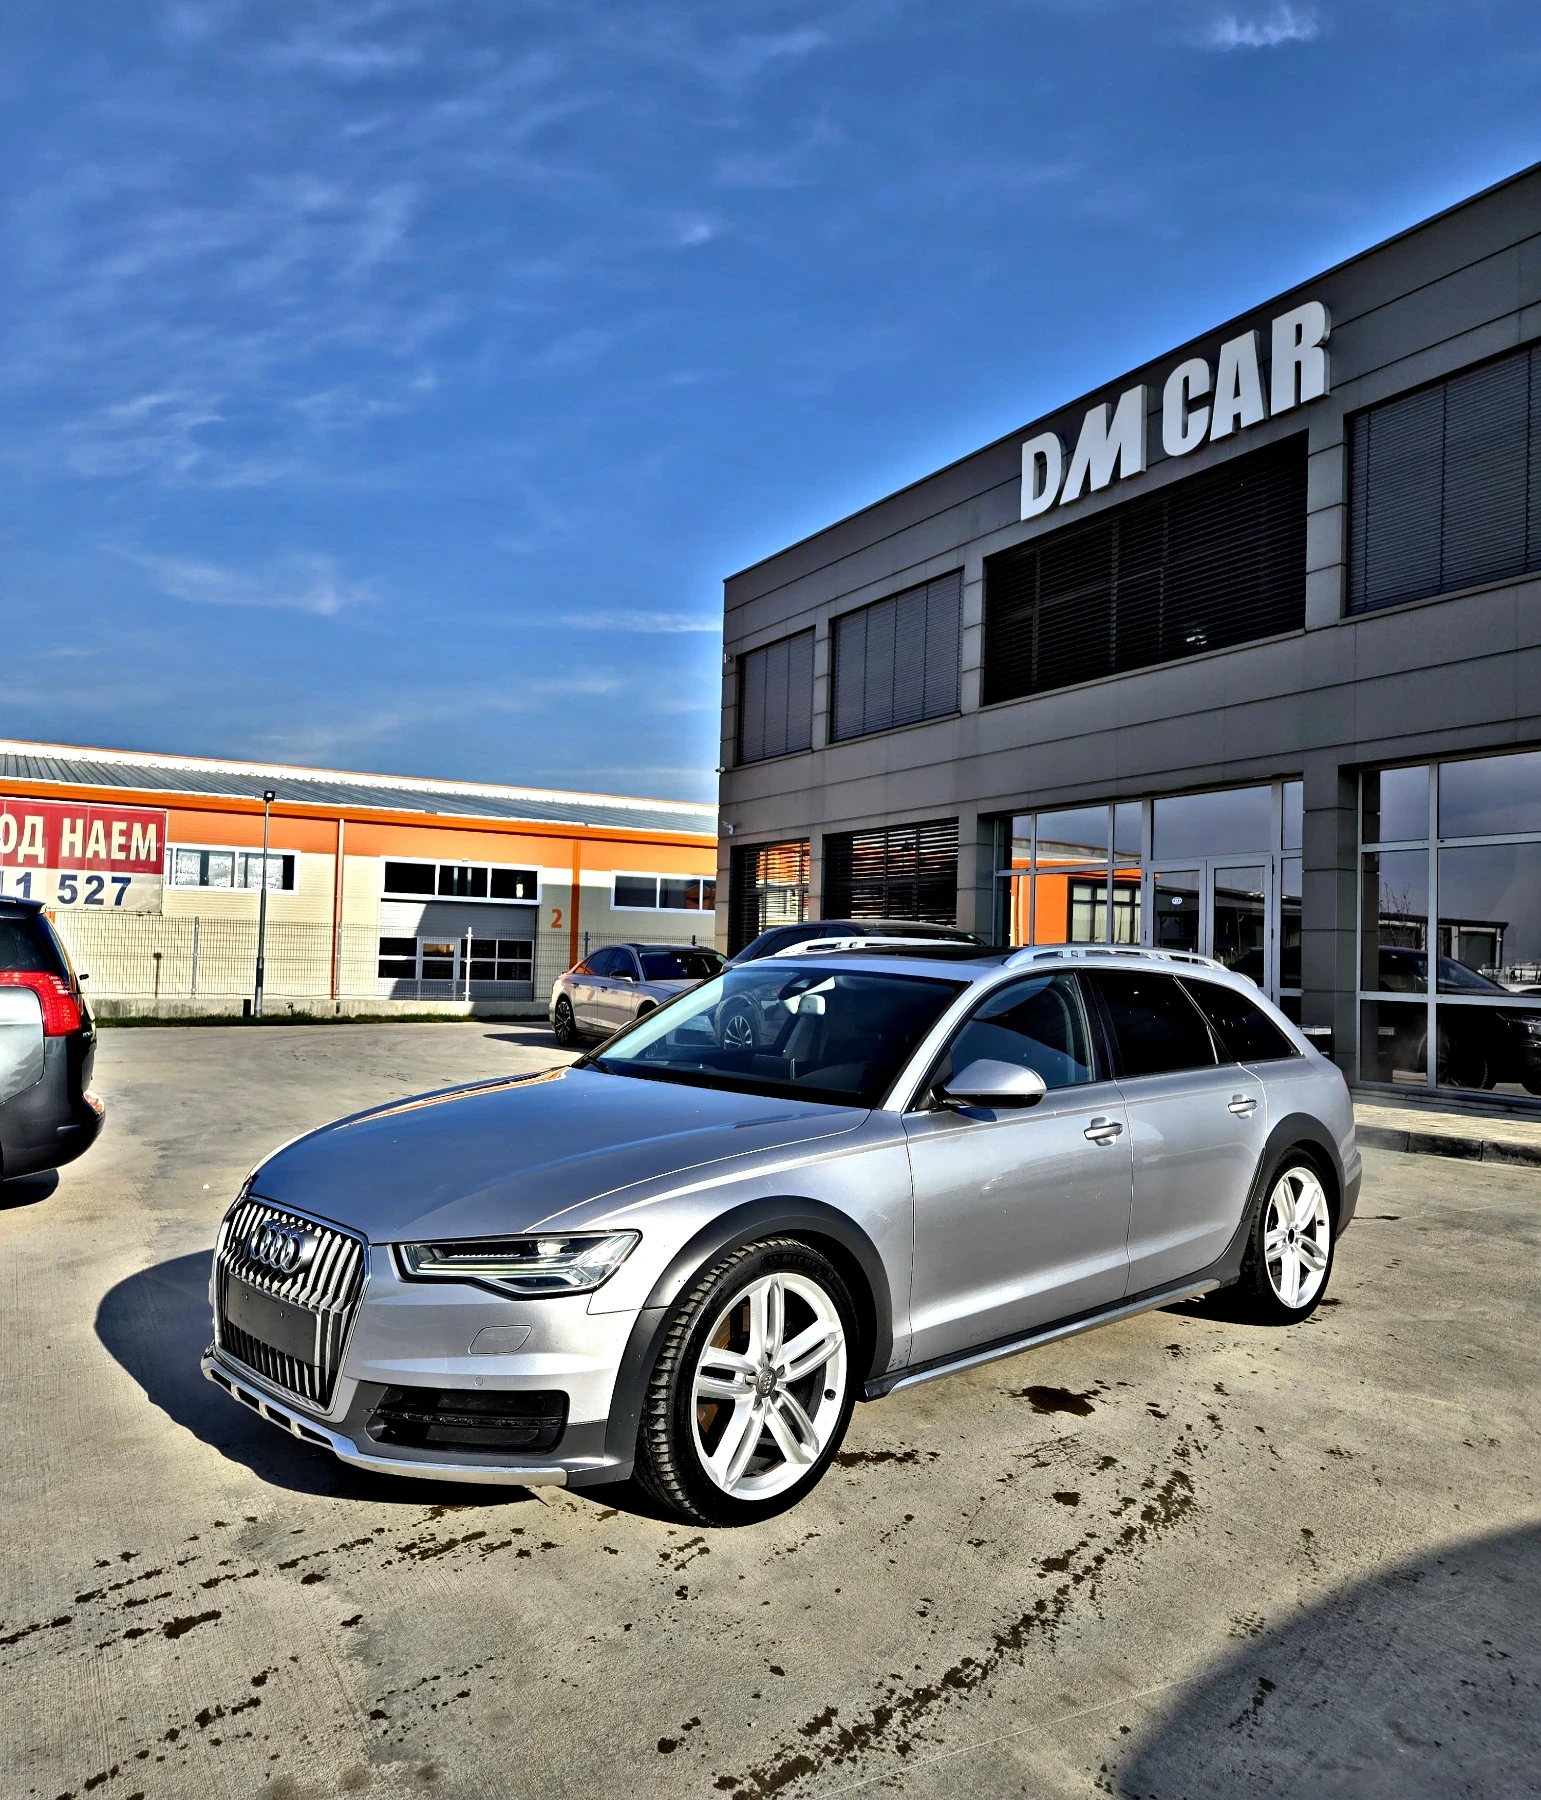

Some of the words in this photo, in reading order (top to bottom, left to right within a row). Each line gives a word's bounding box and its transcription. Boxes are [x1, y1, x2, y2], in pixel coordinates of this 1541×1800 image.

[1020, 384, 1147, 521] DM
[1162, 301, 1332, 457] CAR
[61, 817, 157, 862] НАЕМ
[57, 873, 132, 906] 527
[551, 908, 562, 928] 2
